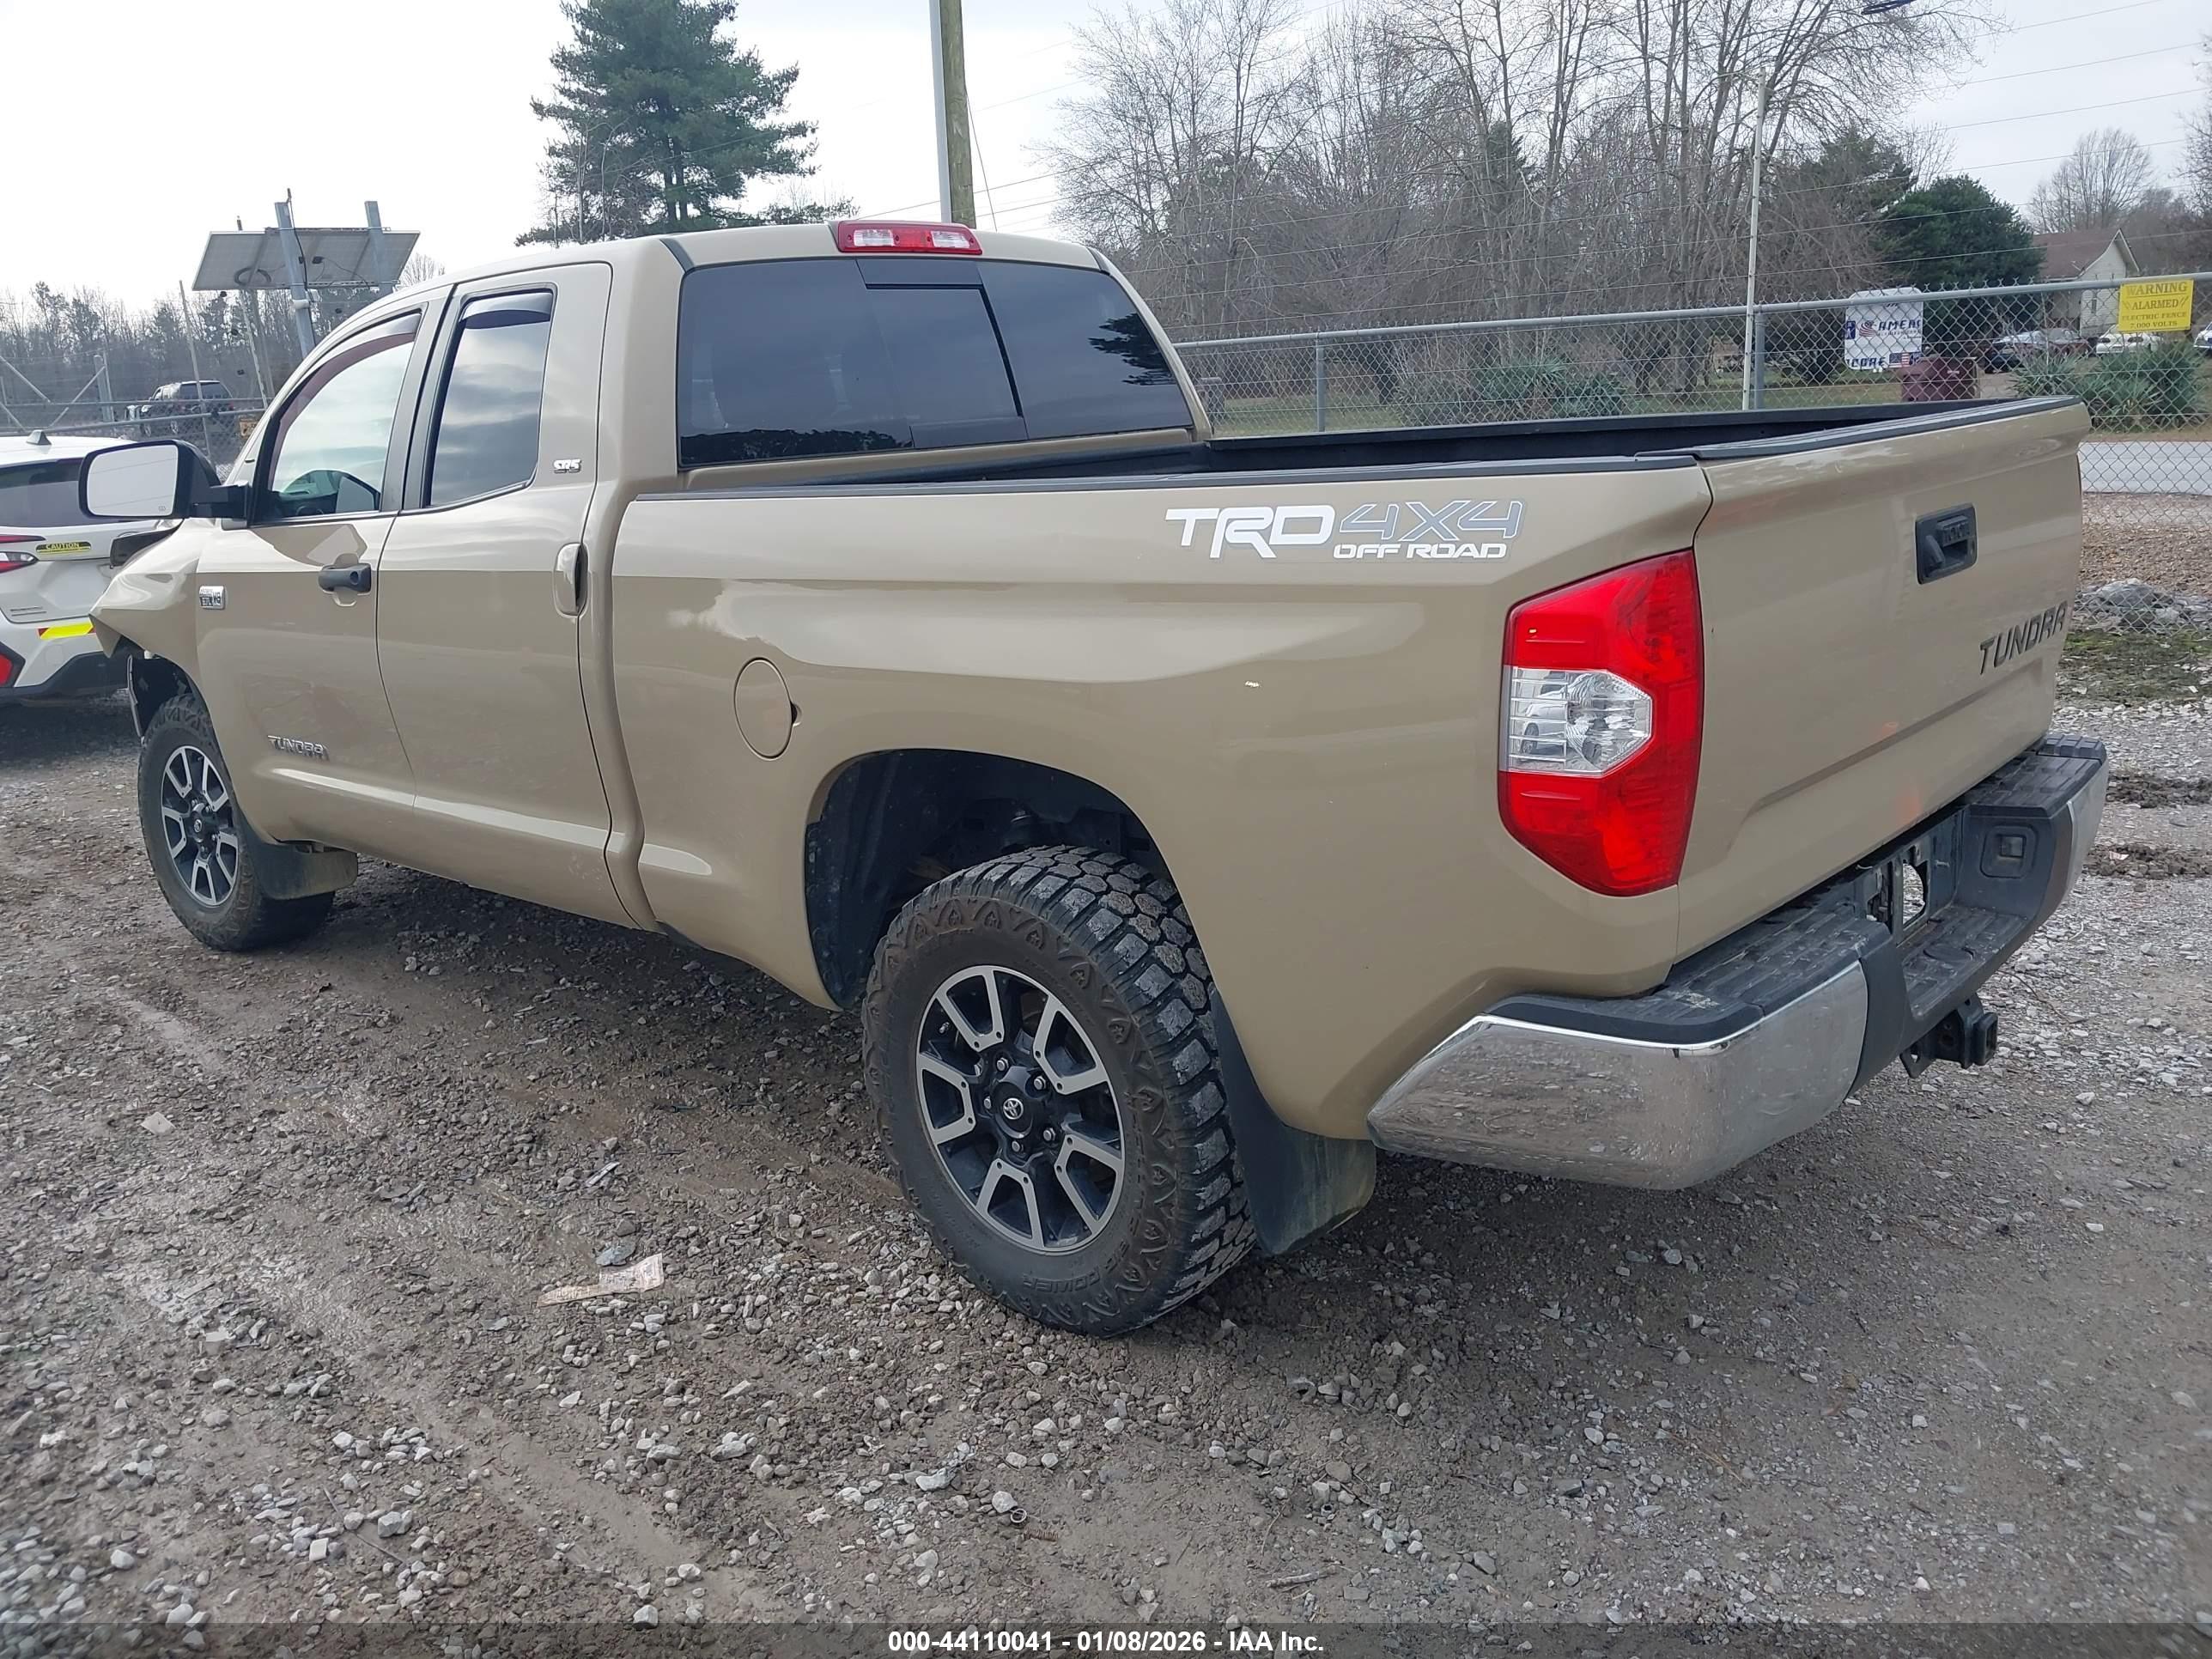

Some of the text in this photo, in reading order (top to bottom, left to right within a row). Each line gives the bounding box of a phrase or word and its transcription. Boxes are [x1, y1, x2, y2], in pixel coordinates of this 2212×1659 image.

[2125, 282, 2187, 296] WARNING
[2132, 299, 2179, 310] ALARMED
[1165, 500, 1522, 559] TRD 4X4
[46, 542, 80, 550] CAUTION
[1333, 543, 1507, 559] OFF ROAD
[1979, 600, 2069, 676] TUNDRA
[267, 734, 330, 762] TUNDRA
